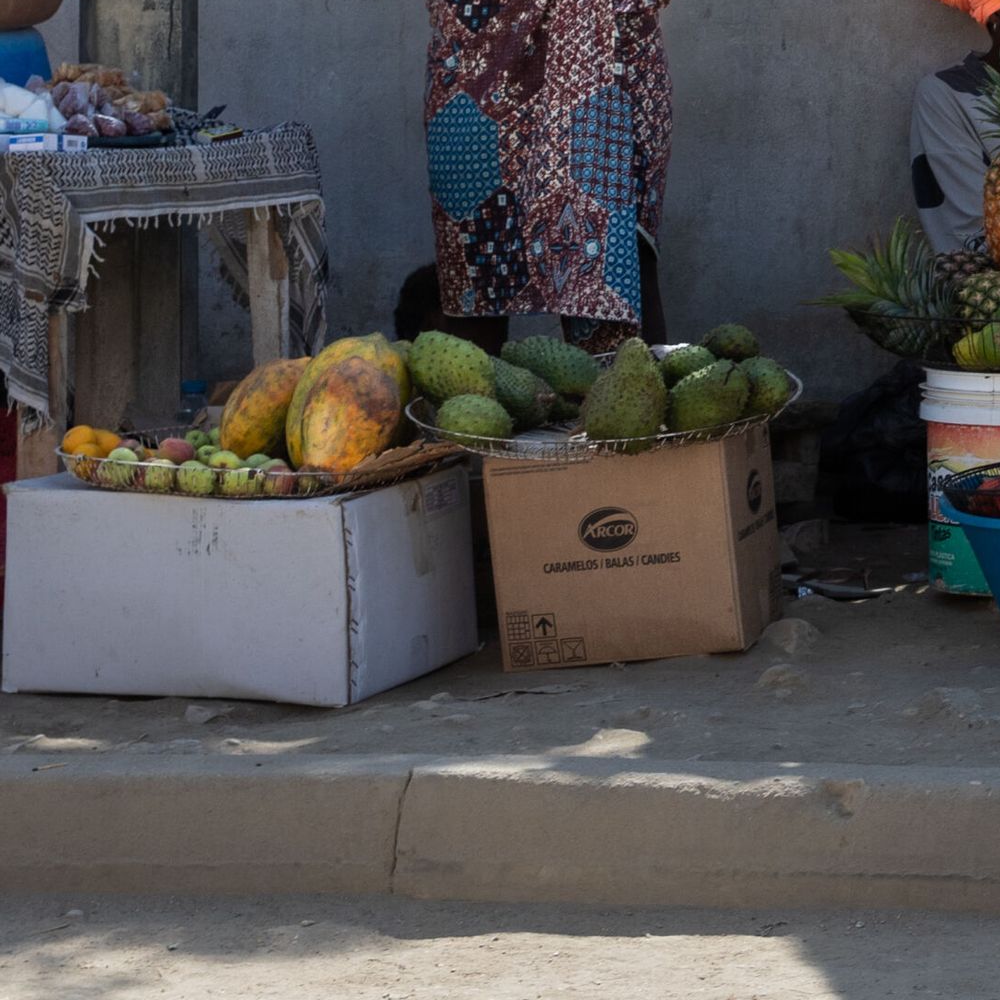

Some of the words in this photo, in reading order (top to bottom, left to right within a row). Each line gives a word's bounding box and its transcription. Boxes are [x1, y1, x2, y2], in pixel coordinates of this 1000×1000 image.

[583, 521, 635, 540] ARCOR
[543, 559, 598, 574] CARAMELOS
[605, 555, 635, 568] BALAS
[642, 551, 681, 566] CANDIES
